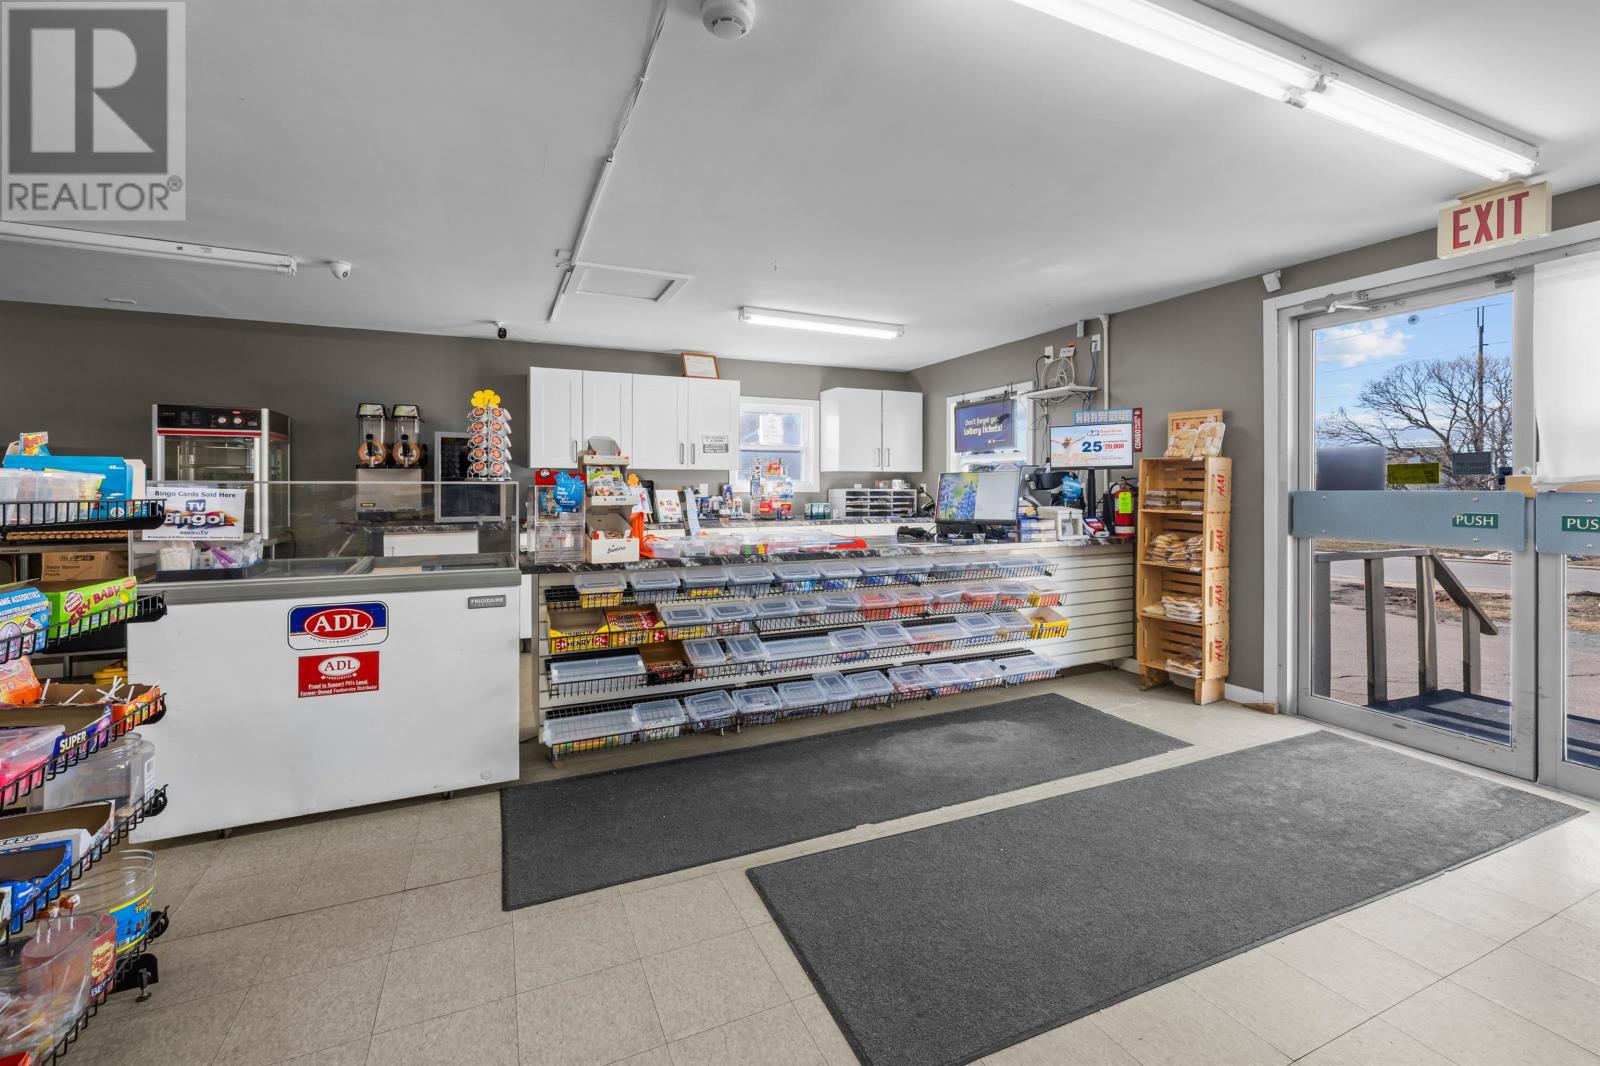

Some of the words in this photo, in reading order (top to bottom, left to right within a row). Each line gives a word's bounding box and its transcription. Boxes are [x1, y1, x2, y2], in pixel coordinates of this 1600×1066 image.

[1453, 191, 1530, 249] EXIT
[1082, 441, 1103, 453] 25
[155, 490, 176, 499] Bingo
[187, 502, 205, 511] TV
[164, 512, 225, 526] Bingo!
[1456, 515, 1494, 526] PUSH
[1567, 518, 1600, 530] PUS
[93, 586, 120, 605] BABY
[312, 613, 367, 633] ADL
[324, 659, 356, 672] ADL
[60, 730, 87, 753] SUPER
